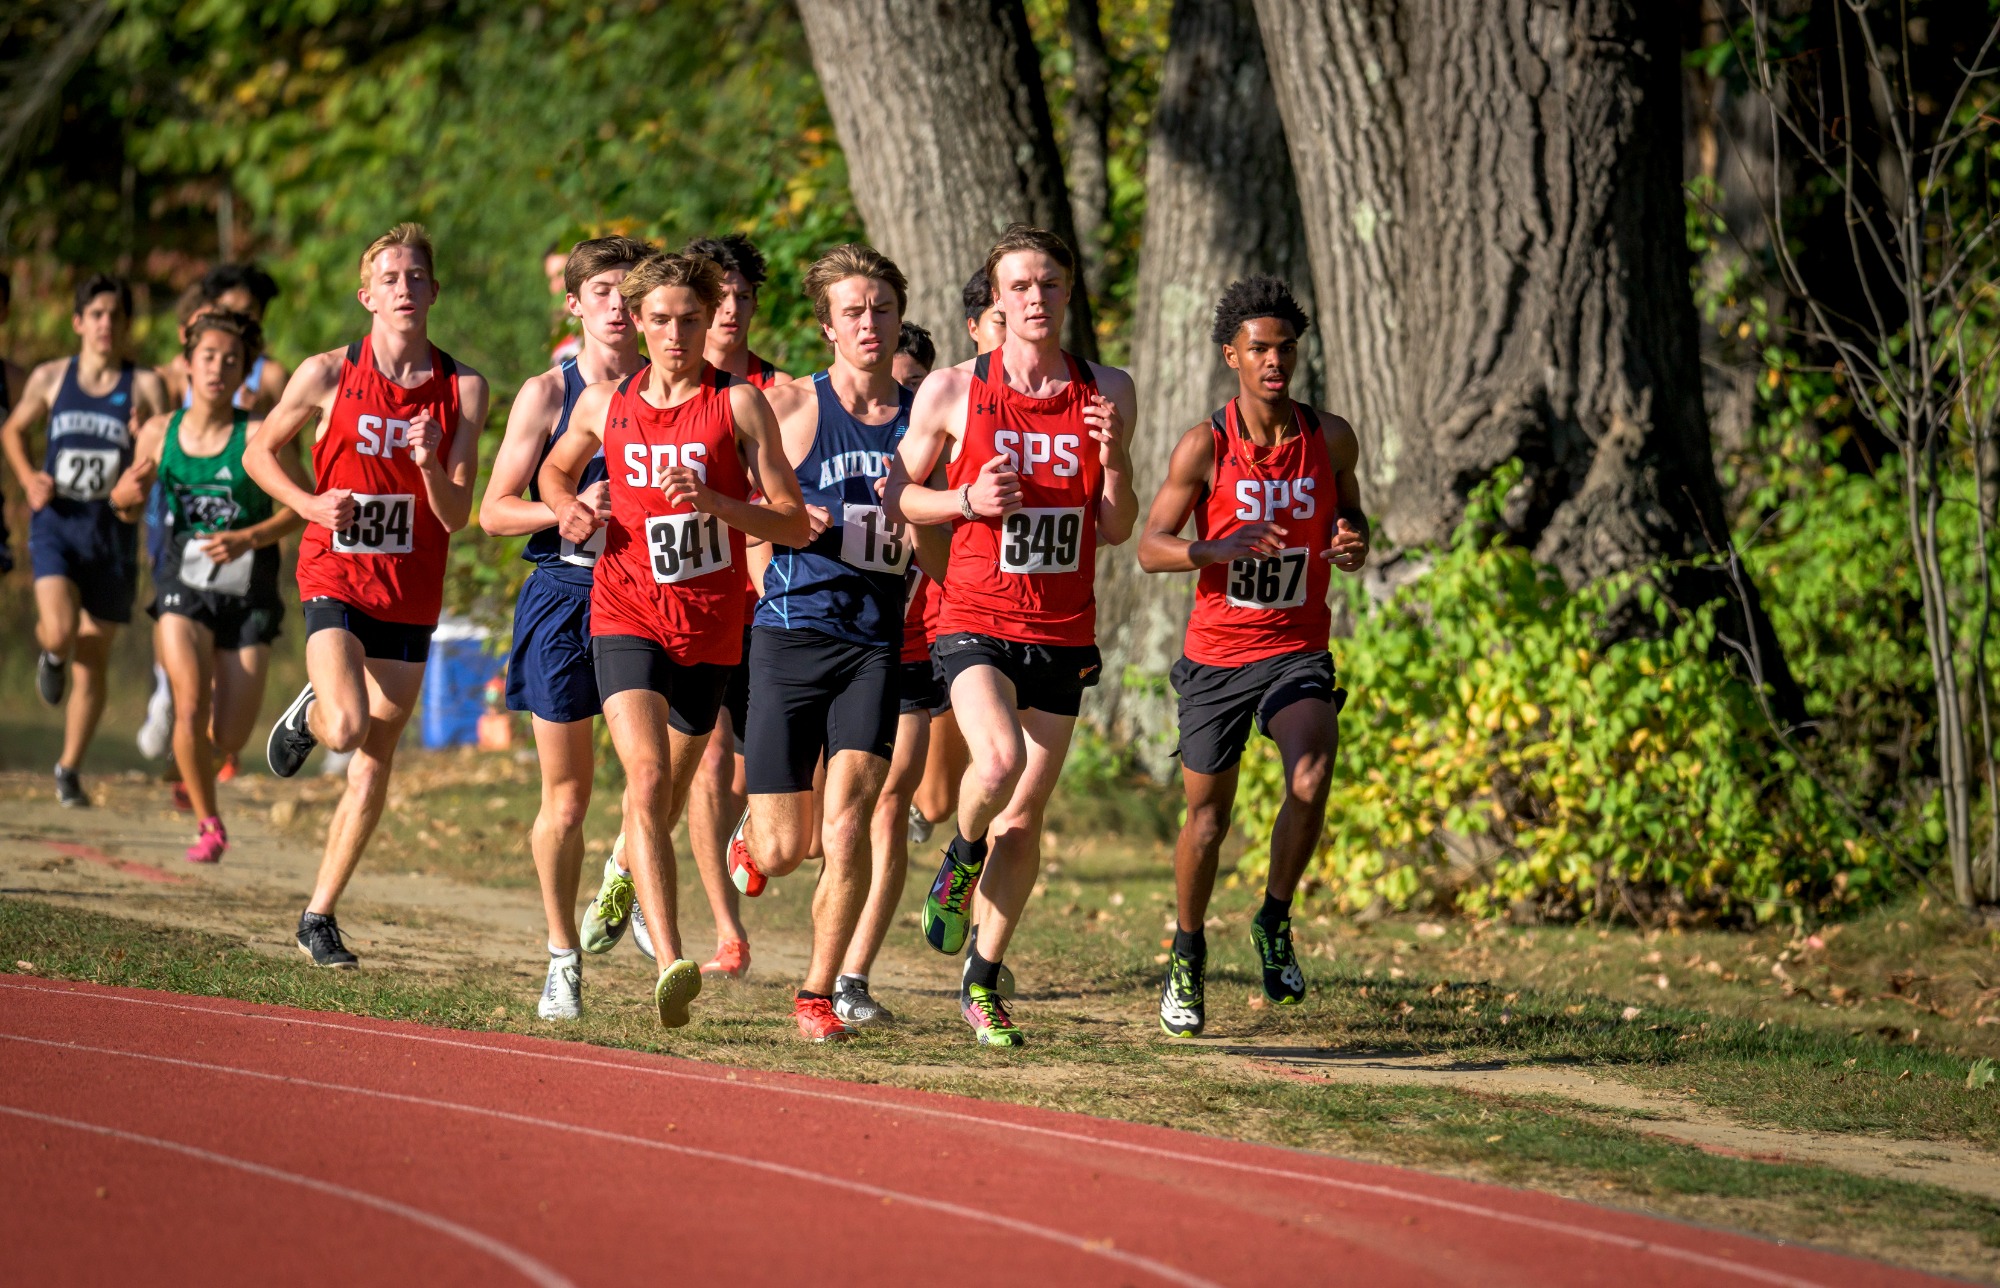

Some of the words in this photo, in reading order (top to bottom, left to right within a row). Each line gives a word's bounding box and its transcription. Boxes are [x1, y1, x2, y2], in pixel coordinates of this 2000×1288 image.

[356, 413, 416, 461] SP
[994, 429, 1080, 477] SPS
[70, 456, 105, 493] 23
[624, 442, 707, 488] SPS
[1235, 477, 1315, 521] SPS
[651, 515, 722, 576] 341
[862, 510, 906, 567] 13
[1005, 512, 1080, 567] 349
[1231, 552, 1306, 603] 367
